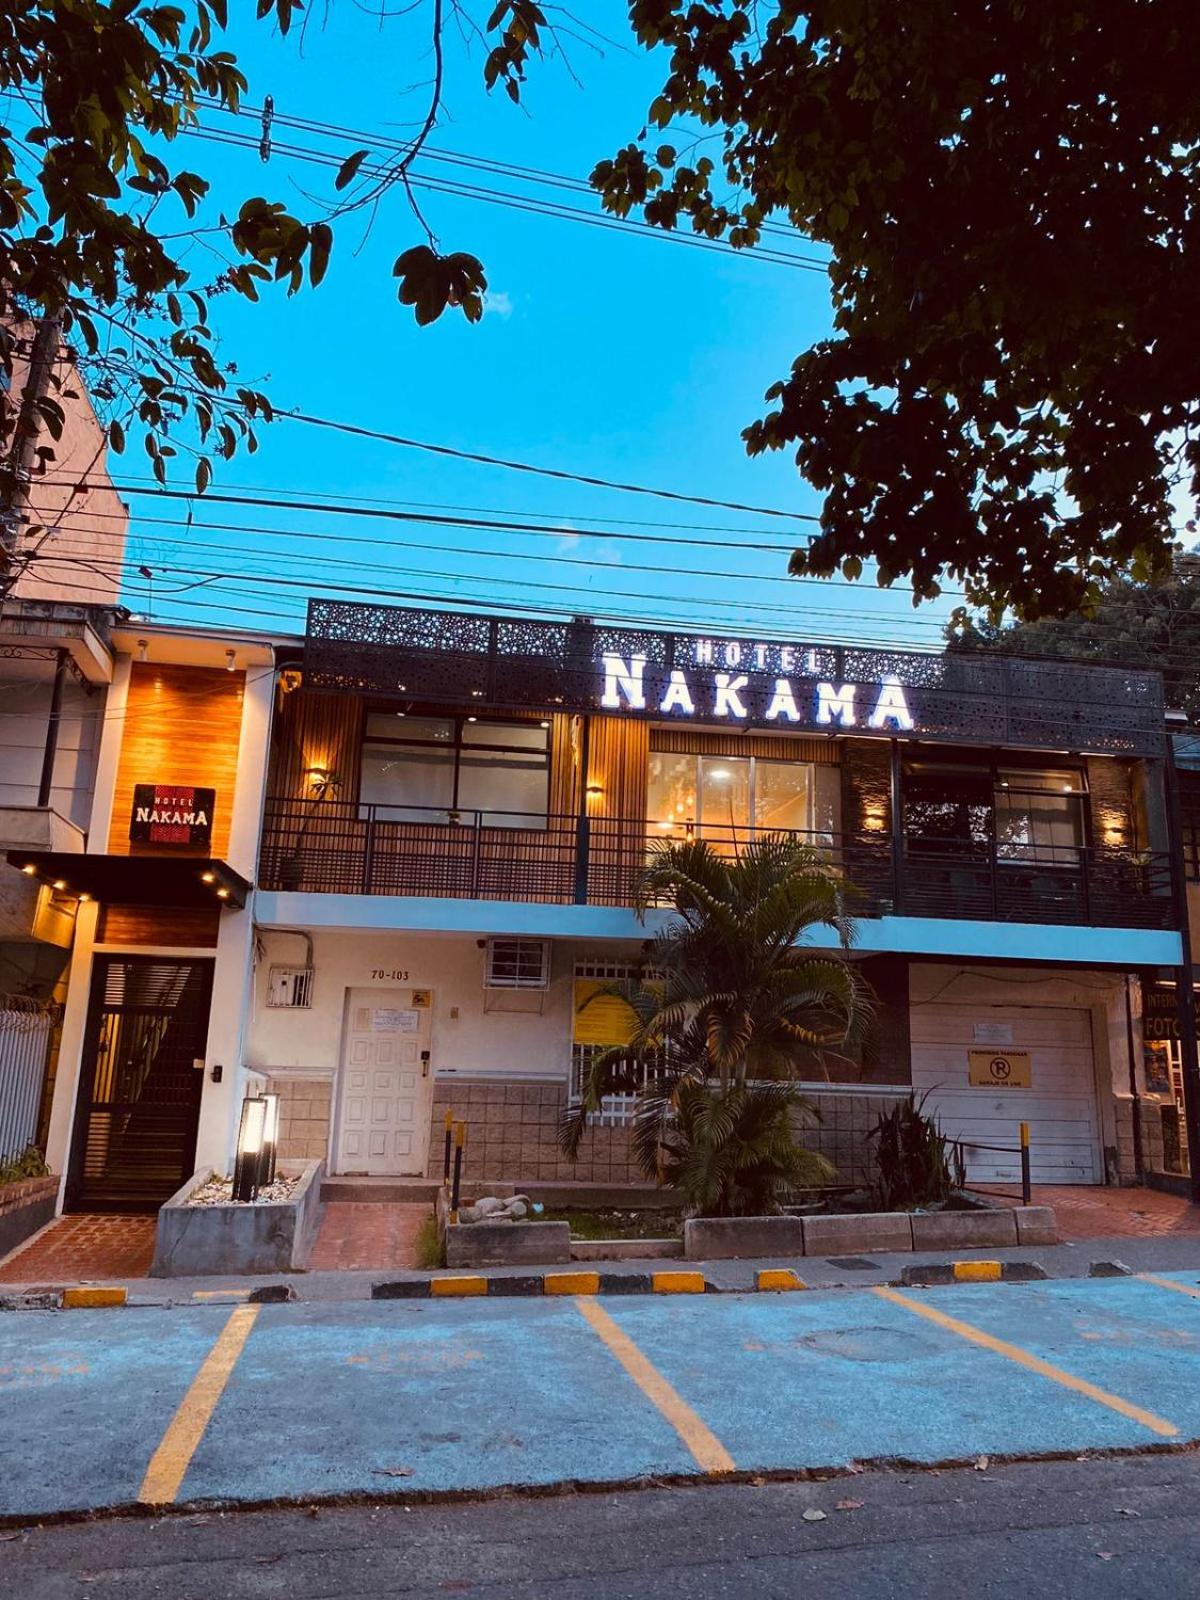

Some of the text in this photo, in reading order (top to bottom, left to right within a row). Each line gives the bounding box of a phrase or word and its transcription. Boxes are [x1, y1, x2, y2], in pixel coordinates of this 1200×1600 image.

[696, 638, 822, 673] HOTEL
[600, 652, 914, 730] NAKAMA
[154, 797, 193, 806] HOTEL
[135, 807, 208, 826] NAKAMA
[371, 969, 409, 981] 70-103
